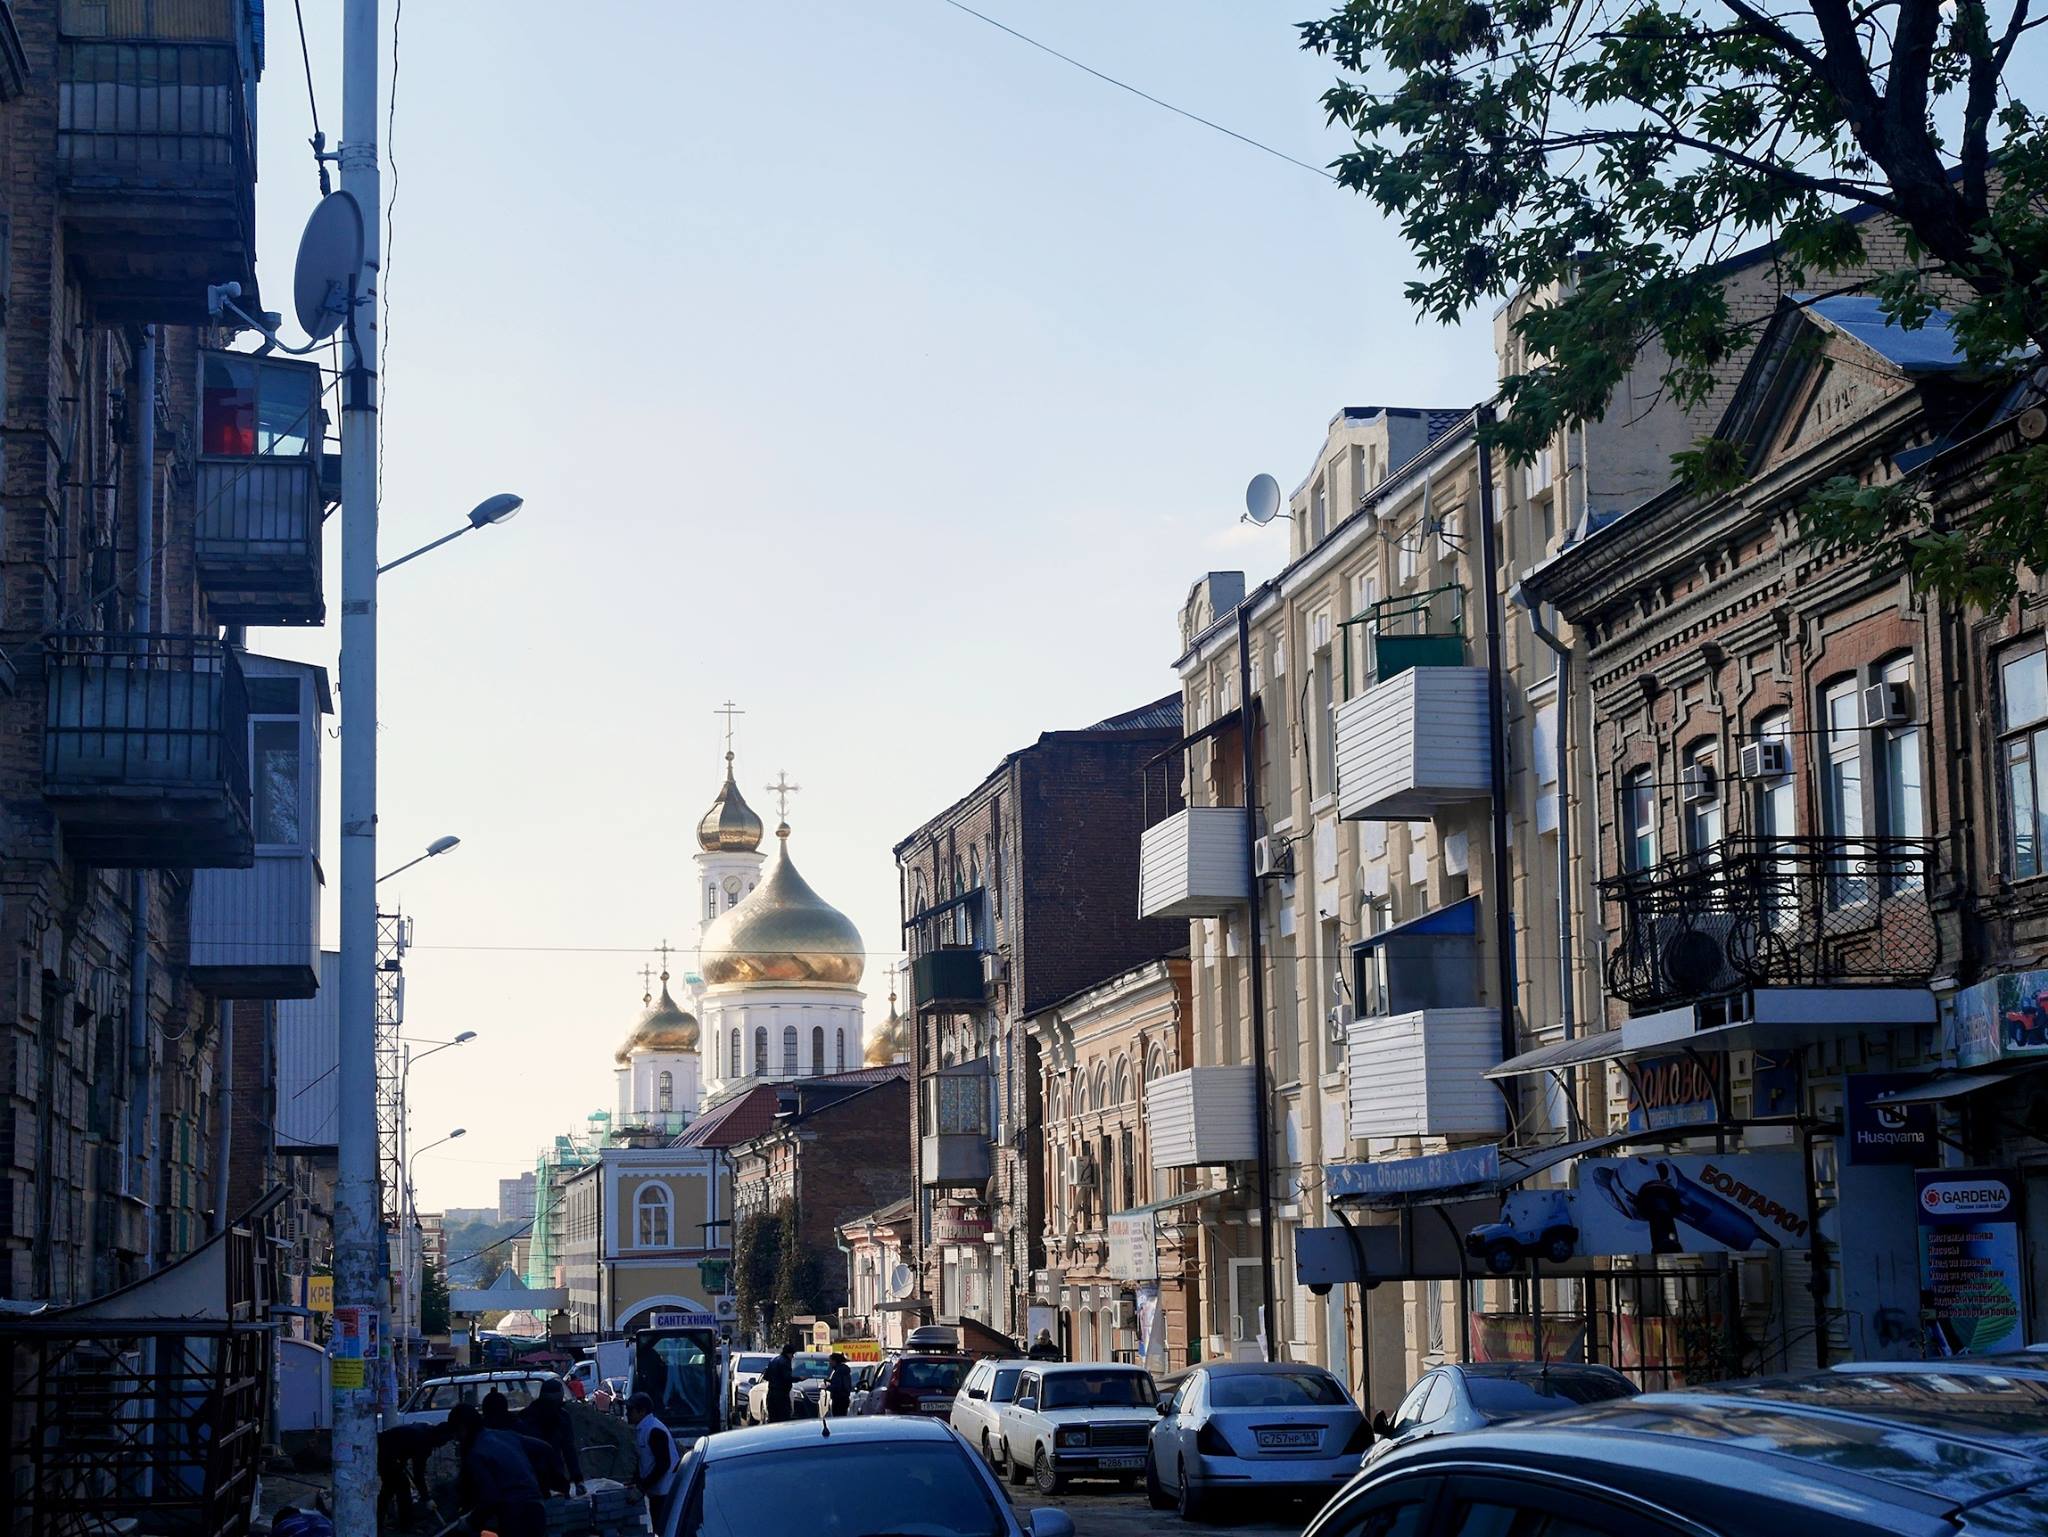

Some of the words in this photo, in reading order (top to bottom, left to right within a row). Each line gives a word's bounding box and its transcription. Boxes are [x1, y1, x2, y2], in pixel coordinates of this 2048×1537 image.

[1856, 1130, 1925, 1144] Husqvarna
[1700, 1164, 1808, 1238] БОЛГАРКИ
[1942, 1188, 2007, 1204] GARDENA
[311, 1286, 334, 1303] КРЕ
